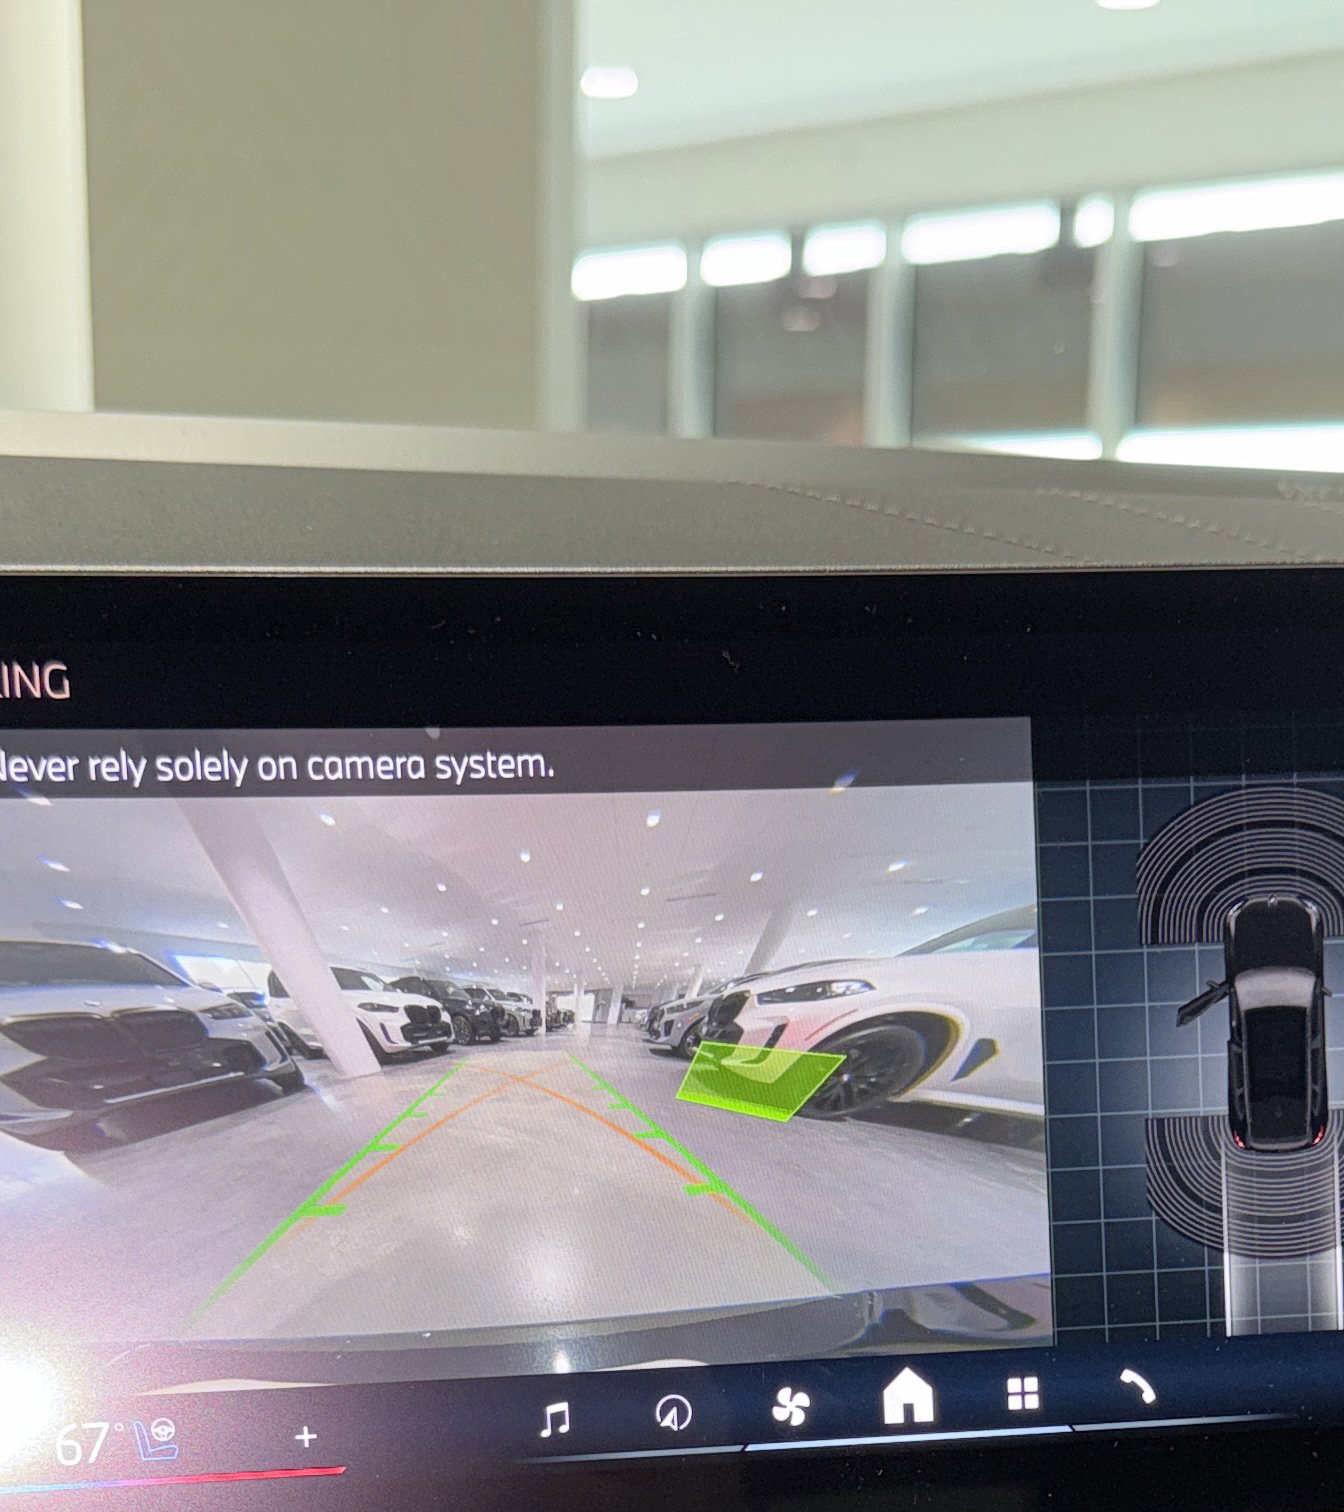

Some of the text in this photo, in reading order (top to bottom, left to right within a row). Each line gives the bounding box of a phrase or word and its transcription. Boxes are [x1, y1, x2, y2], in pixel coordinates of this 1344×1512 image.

[88, 747, 147, 787] rely
[156, 747, 248, 787] solely
[258, 754, 297, 781] on
[308, 753, 425, 781] camera
[435, 751, 555, 785] system.
